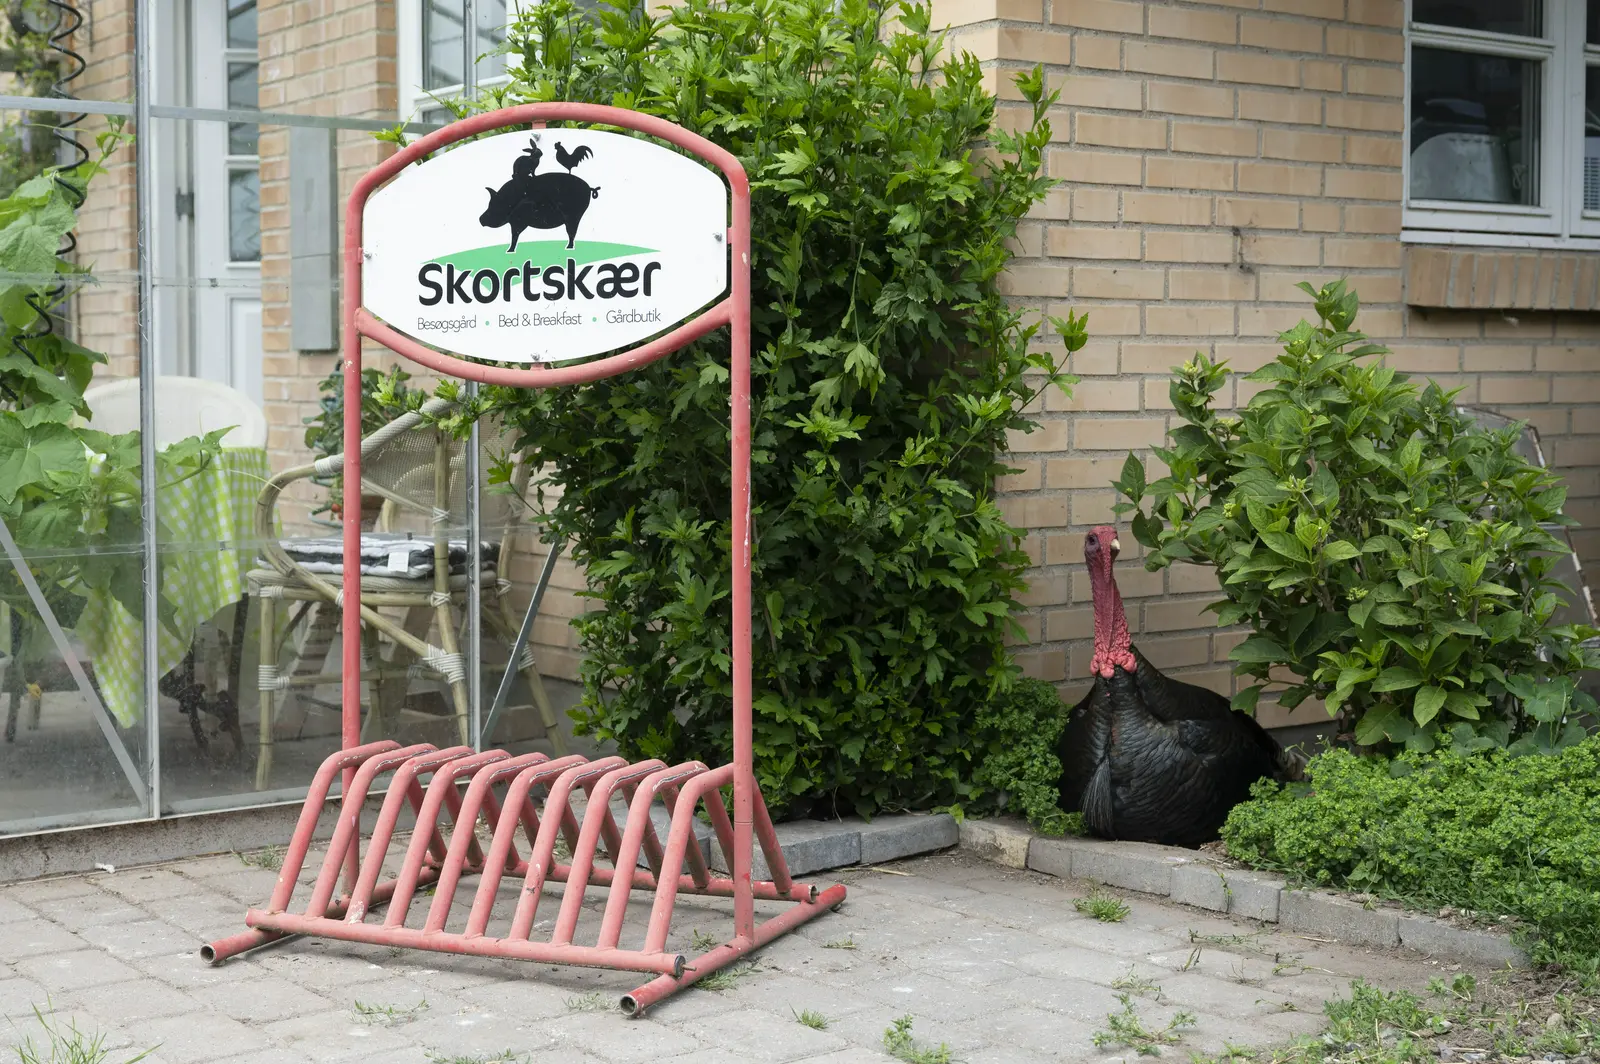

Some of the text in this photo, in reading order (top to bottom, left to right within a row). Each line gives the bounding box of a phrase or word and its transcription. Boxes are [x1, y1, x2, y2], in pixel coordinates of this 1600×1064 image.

[418, 258, 662, 306] Skortskær
[417, 308, 662, 333] Besøgsgård Bed & Breakfast Gårdbutik
